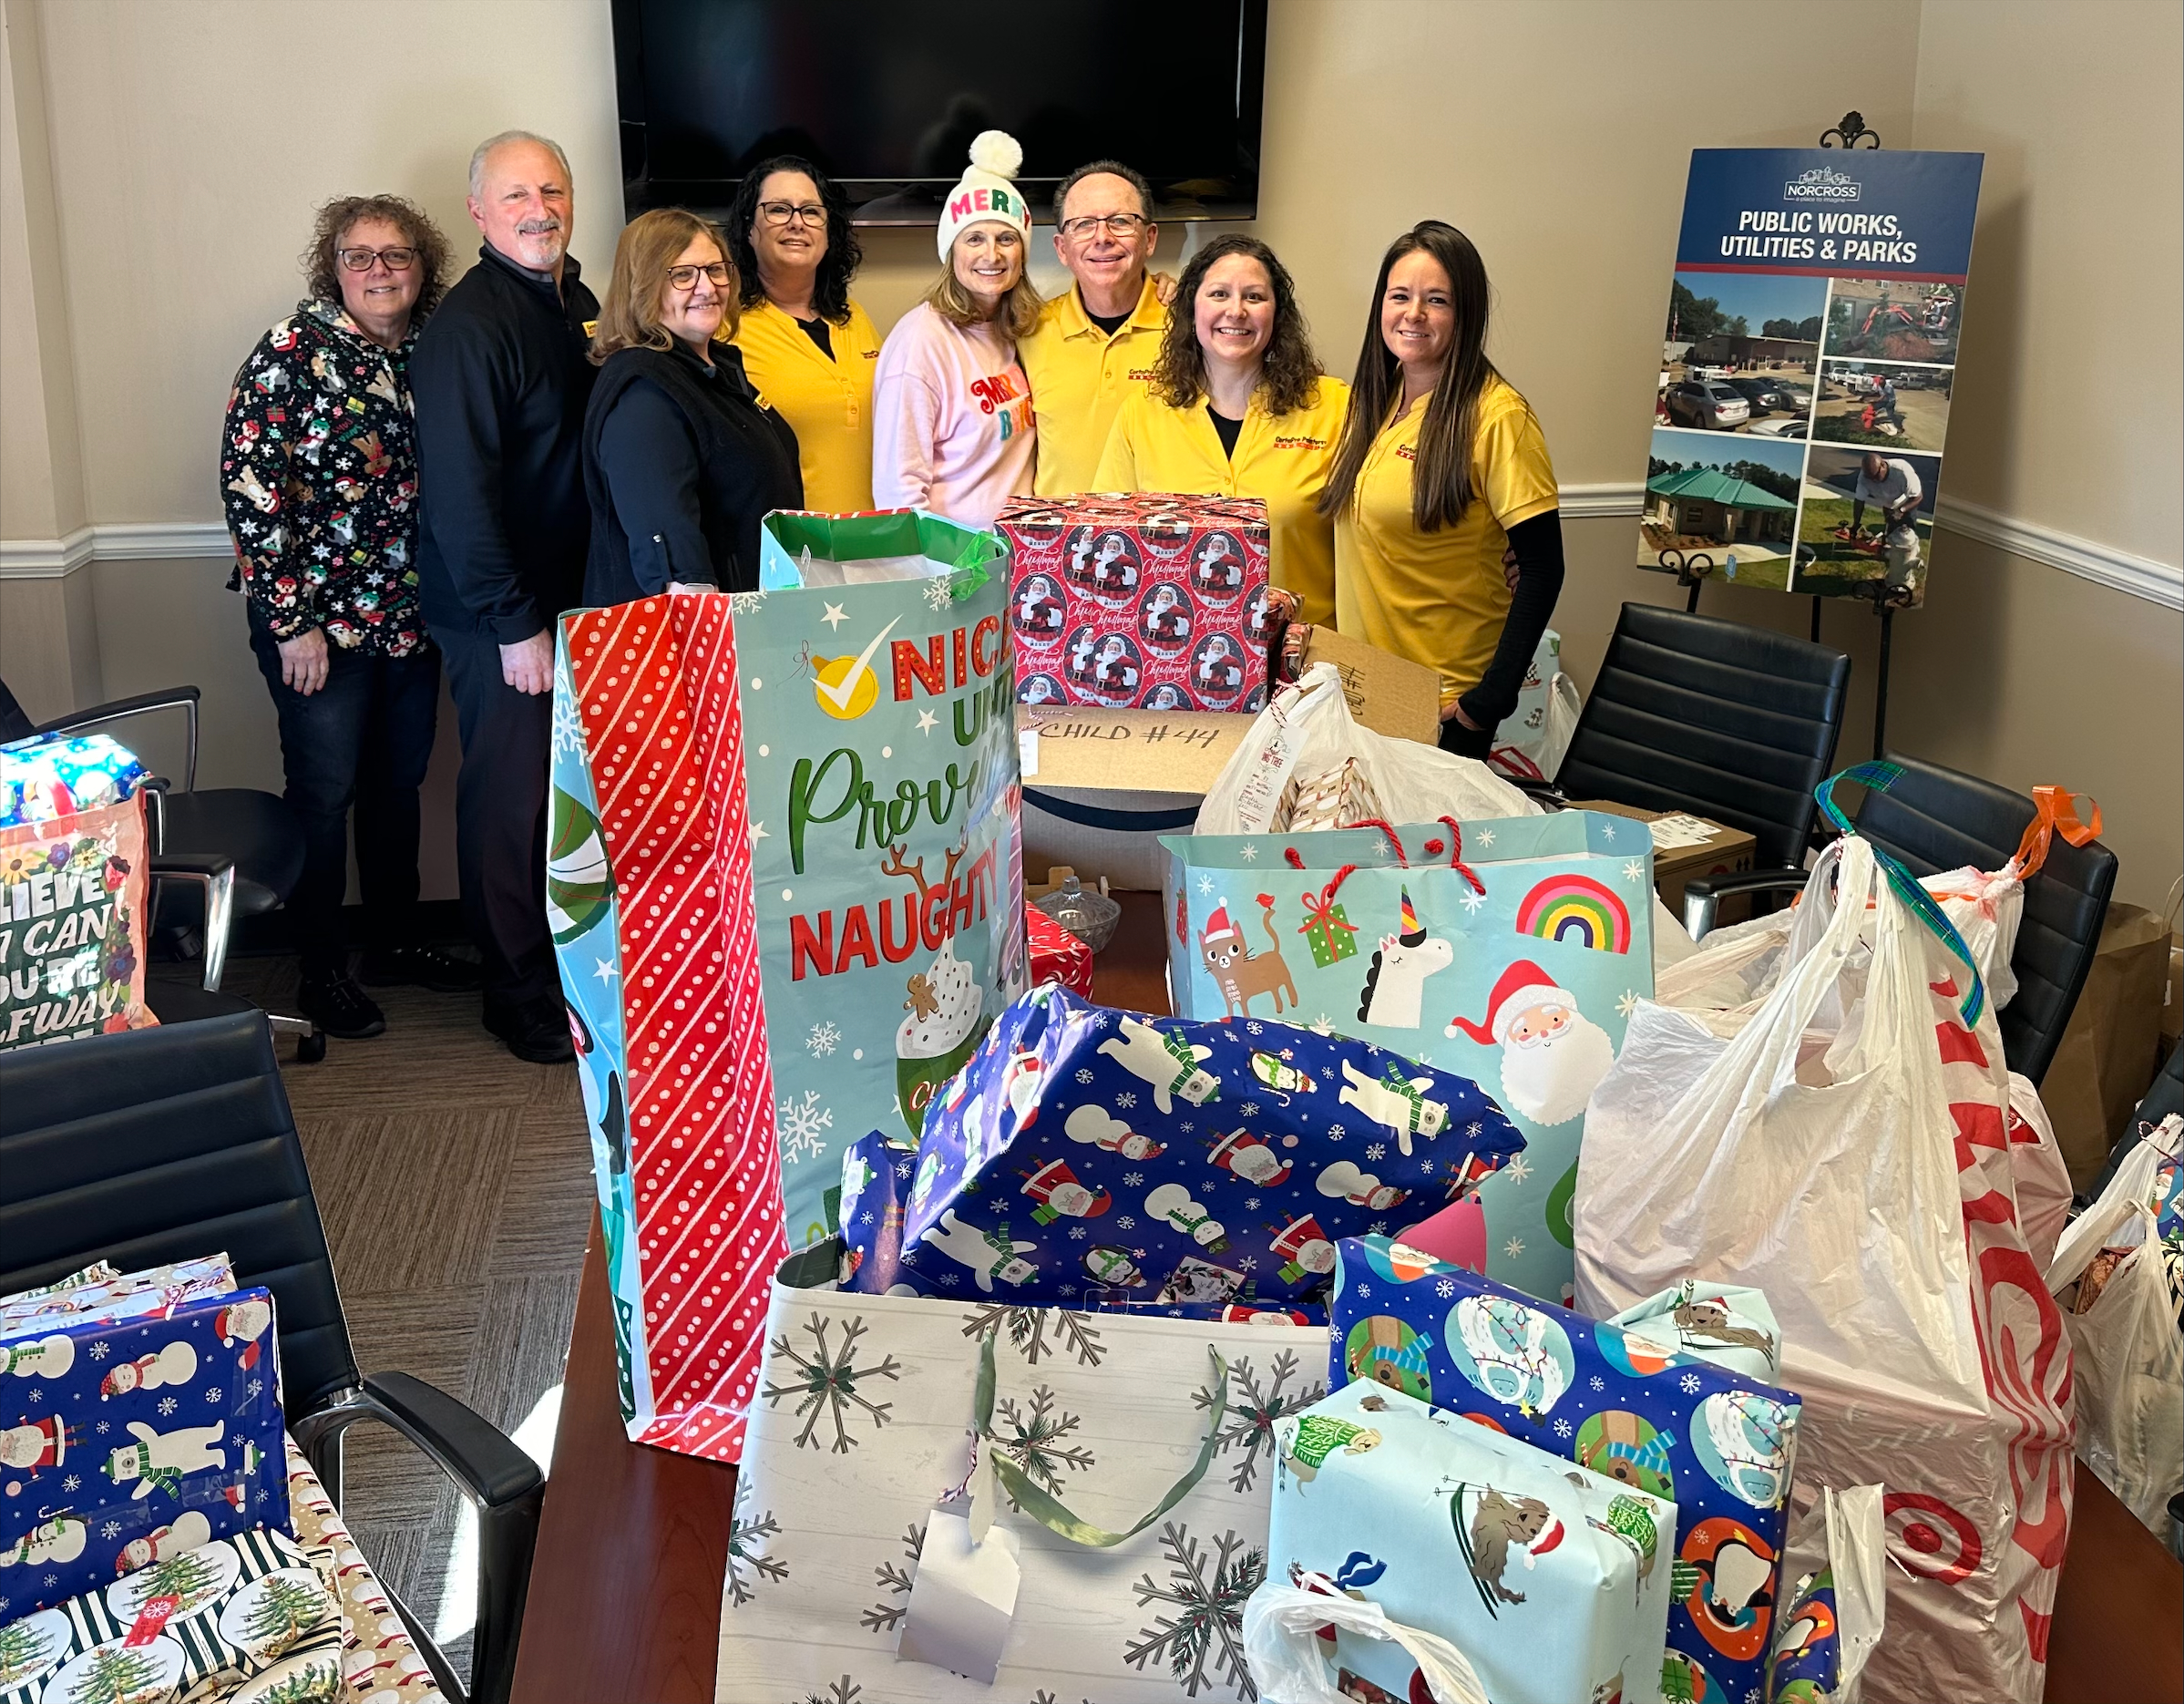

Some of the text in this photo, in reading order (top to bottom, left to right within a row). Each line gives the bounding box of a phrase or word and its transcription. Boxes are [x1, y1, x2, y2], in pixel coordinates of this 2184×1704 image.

[1788, 185, 1857, 198] NORCROSS
[1738, 210, 1902, 241] PUBLIC WORKS,
[1720, 235, 1917, 264] UTILITIES & PARKS
[1142, 557, 1191, 583] Christmas
[1194, 608, 1243, 634] Christmas
[1142, 657, 1191, 684] Christmas
[1039, 723, 1132, 740] CHILD
[790, 837, 1000, 982] NAUGHTY
[23, 903, 113, 957] CAN
[0, 979, 121, 1044] FWAY
